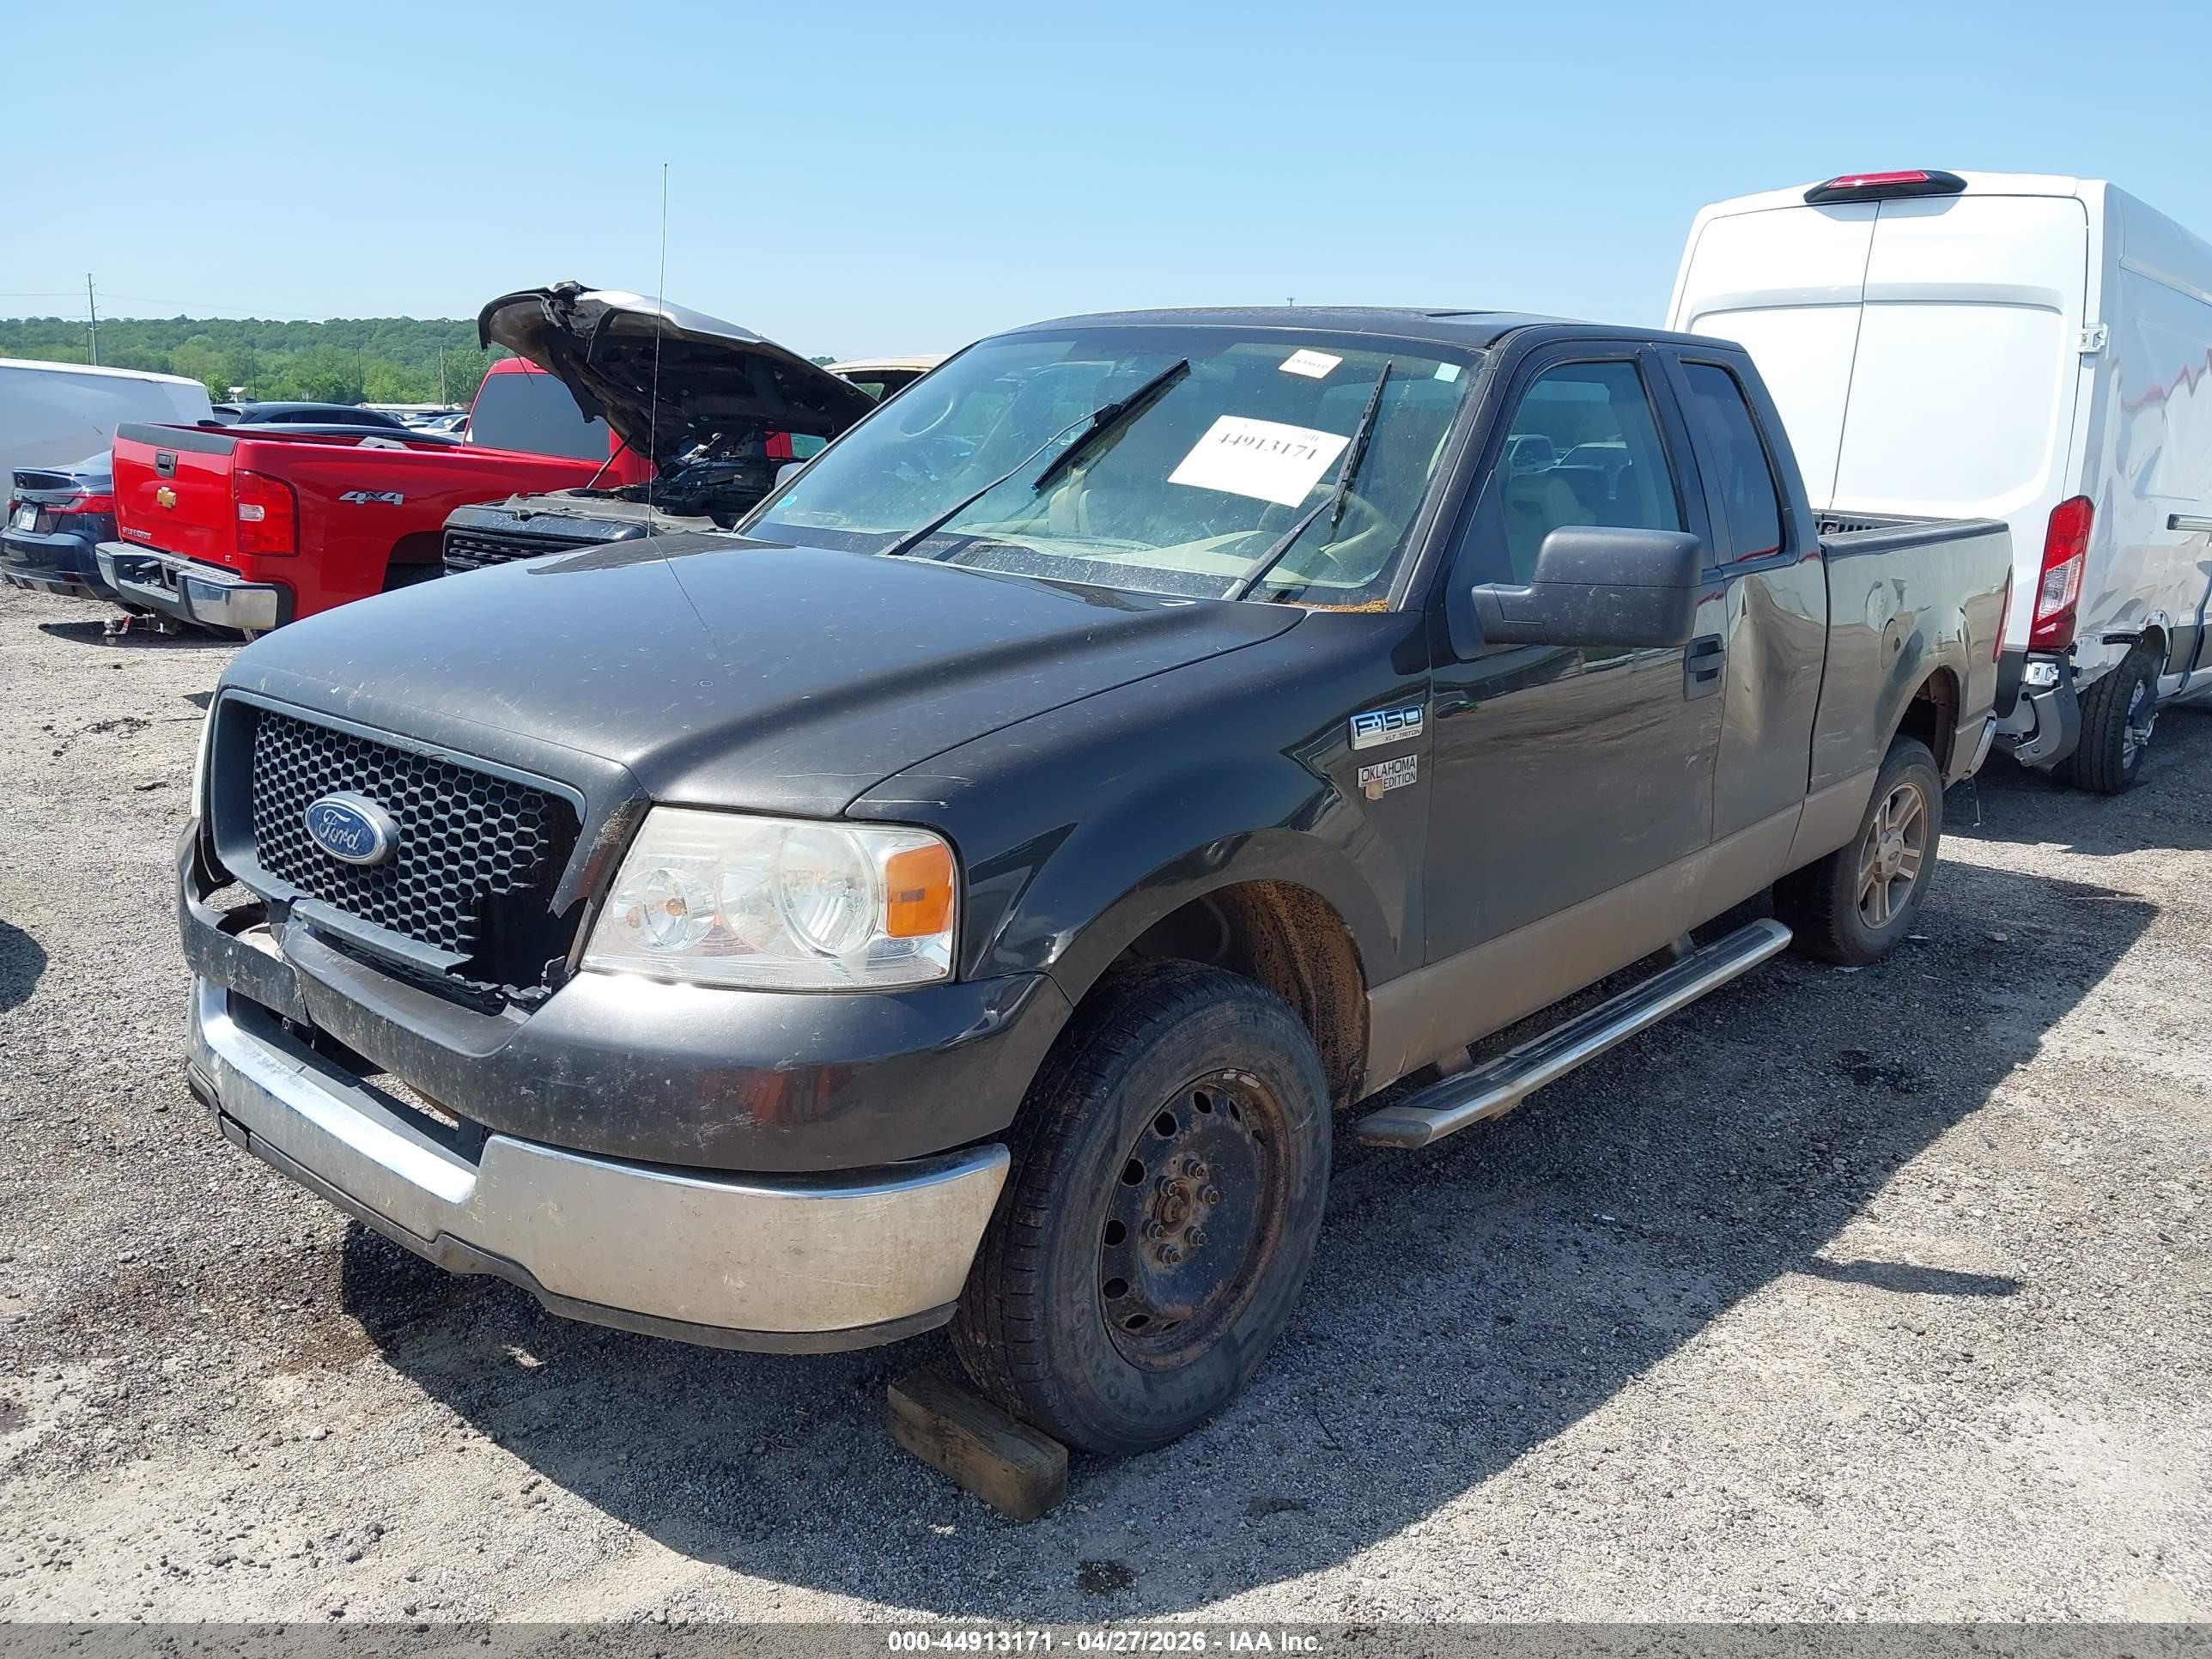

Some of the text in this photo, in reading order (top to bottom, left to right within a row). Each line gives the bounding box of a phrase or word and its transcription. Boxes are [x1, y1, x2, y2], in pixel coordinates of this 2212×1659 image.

[1218, 432, 1319, 460] 44913171
[1354, 707, 1422, 738] F-150
[1384, 728, 1421, 743] XLT TRITON
[1361, 757, 1416, 782] OKLAHOMA
[1383, 772, 1416, 789] EDITION
[319, 808, 361, 850] Ford
